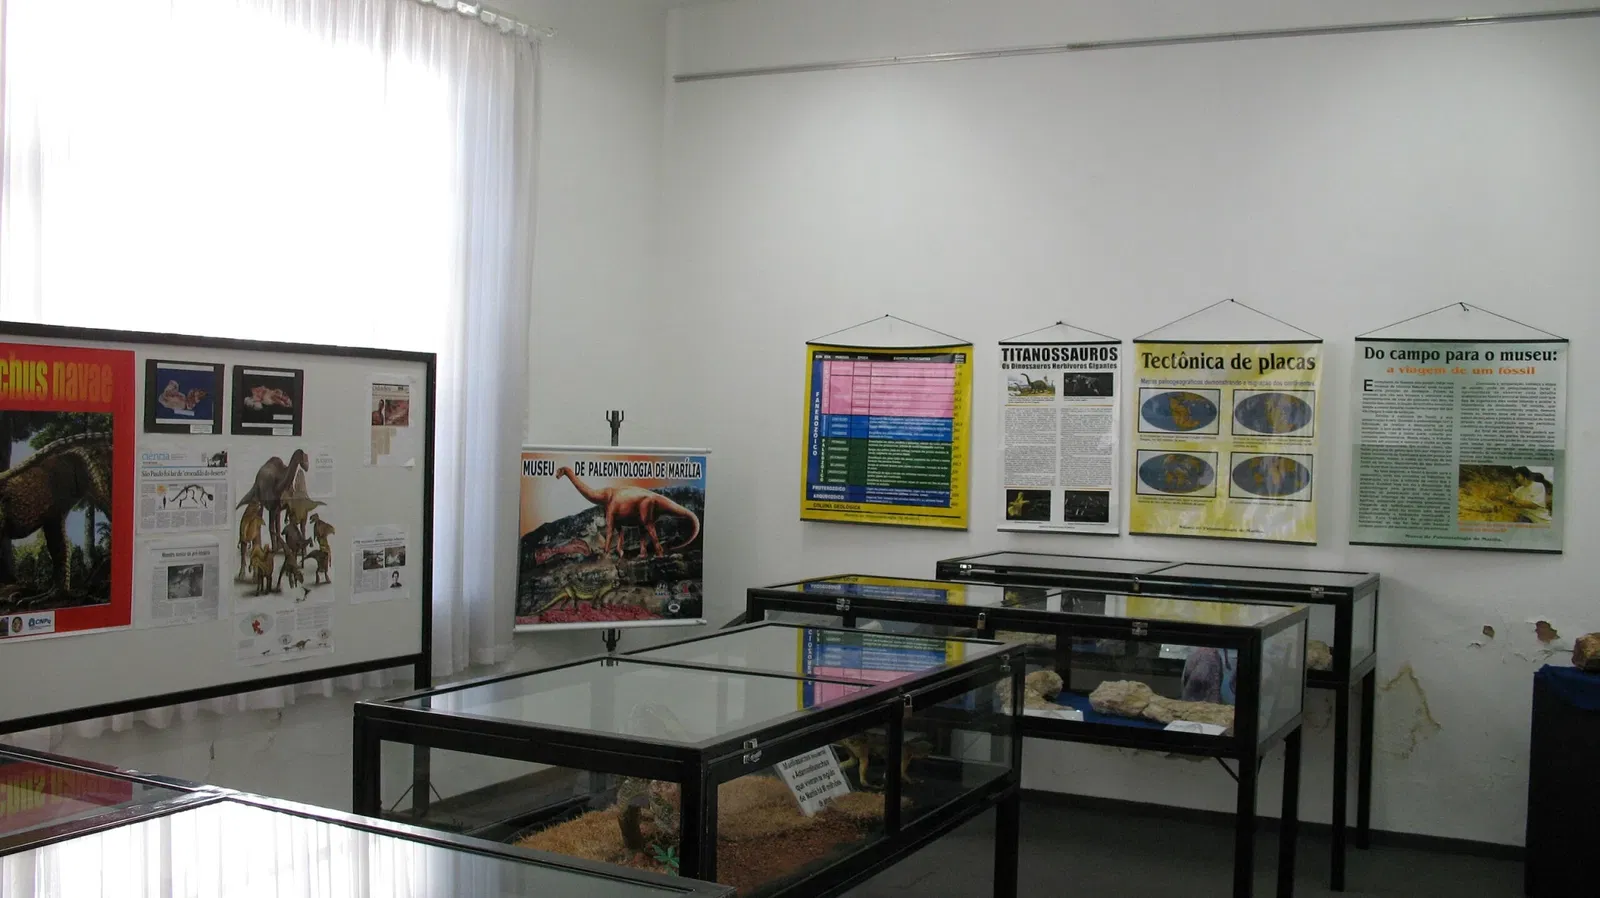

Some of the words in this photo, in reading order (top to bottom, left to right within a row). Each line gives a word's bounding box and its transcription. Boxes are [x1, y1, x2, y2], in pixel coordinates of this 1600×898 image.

[1002, 347, 1118, 362] TITANOSSAUROS
[1142, 351, 1224, 370] Tectônica
[1230, 354, 1252, 370] de
[1259, 353, 1316, 374] placas
[1364, 346, 1384, 360] Do
[1390, 348, 1440, 363] campo
[1446, 348, 1479, 364] para
[1485, 350, 1494, 362] o
[1500, 349, 1558, 362] museu:
[1088, 362, 1118, 370] Gigantes
[1399, 365, 1447, 376] viagem
[1452, 366, 1466, 374] de
[52, 360, 112, 403] navae
[523, 460, 554, 476] MUSEU
[574, 461, 585, 476] DE
[588, 462, 652, 478] PALEONTOLOGIA
[654, 462, 666, 478] DE
[668, 457, 702, 479] MARÍLIA
